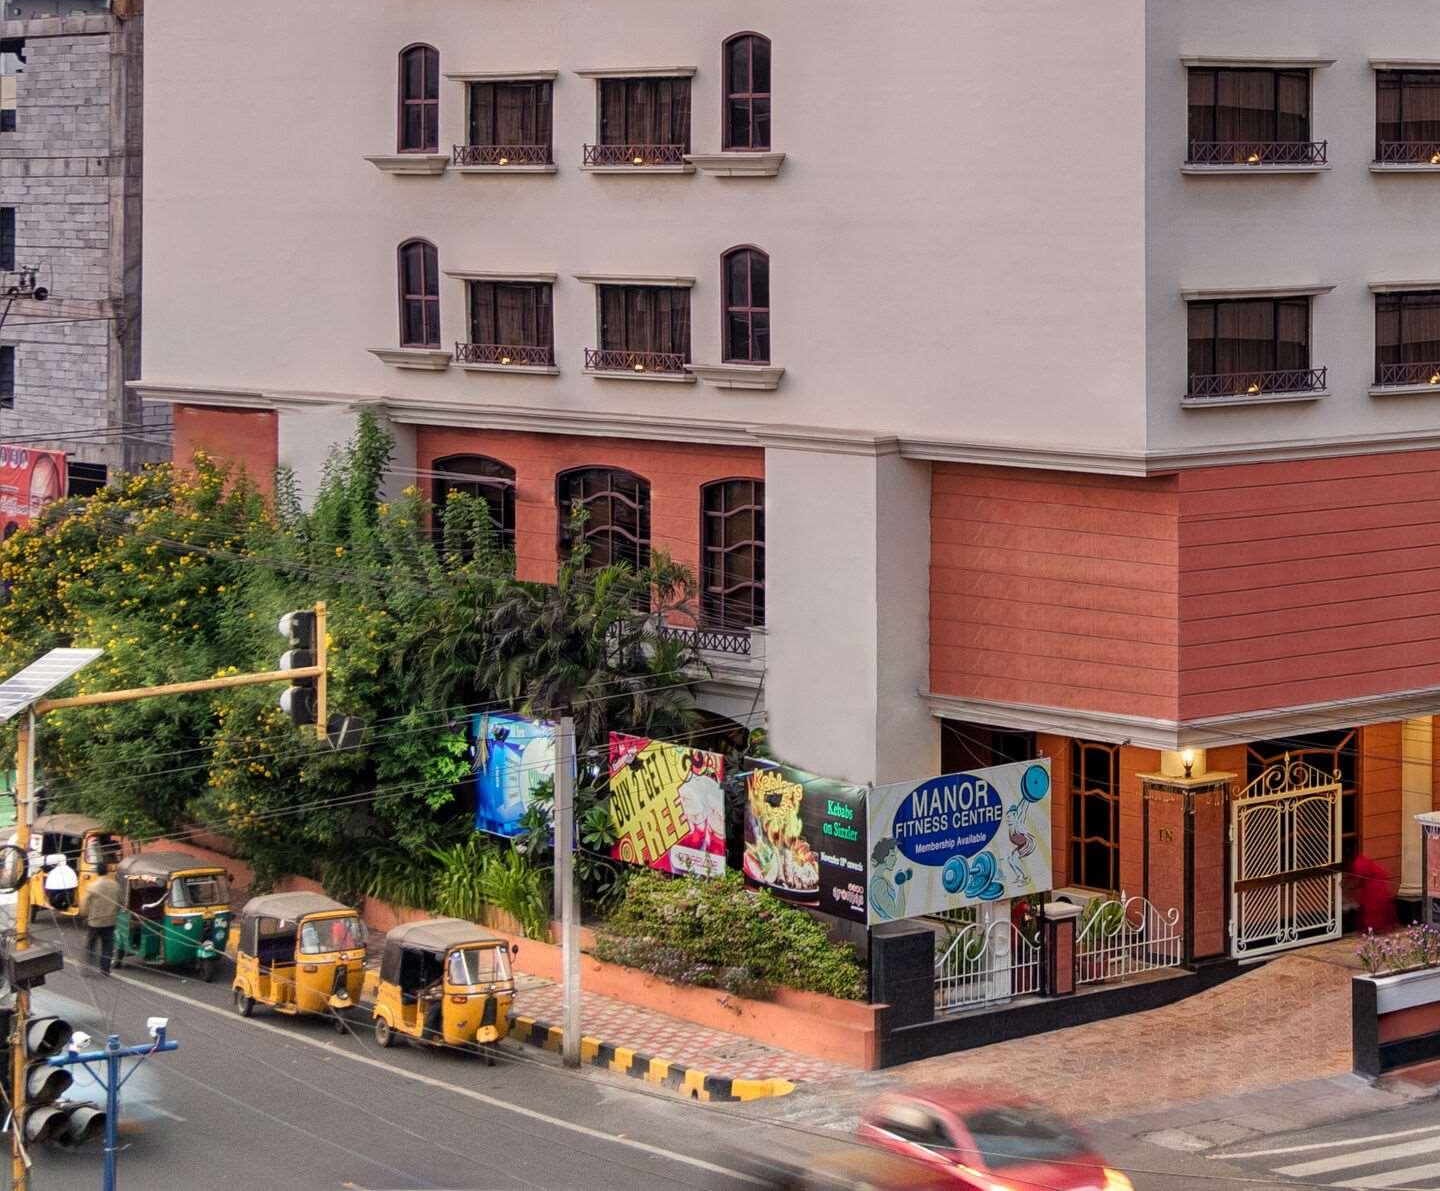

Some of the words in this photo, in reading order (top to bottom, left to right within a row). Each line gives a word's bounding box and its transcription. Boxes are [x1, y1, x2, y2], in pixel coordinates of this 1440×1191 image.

[610, 776, 636, 828] BUY
[631, 771, 645, 809] 2
[640, 752, 665, 800] GET
[911, 779, 989, 820] MANOR
[827, 799, 854, 820] Kebabs
[895, 814, 949, 839] FITNESS
[952, 805, 1002, 828] CENTRE
[629, 797, 691, 866] FREE
[823, 822, 834, 835] on
[834, 822, 858, 842] Sizzler
[915, 838, 956, 854] Membership
[956, 832, 986, 847] Available
